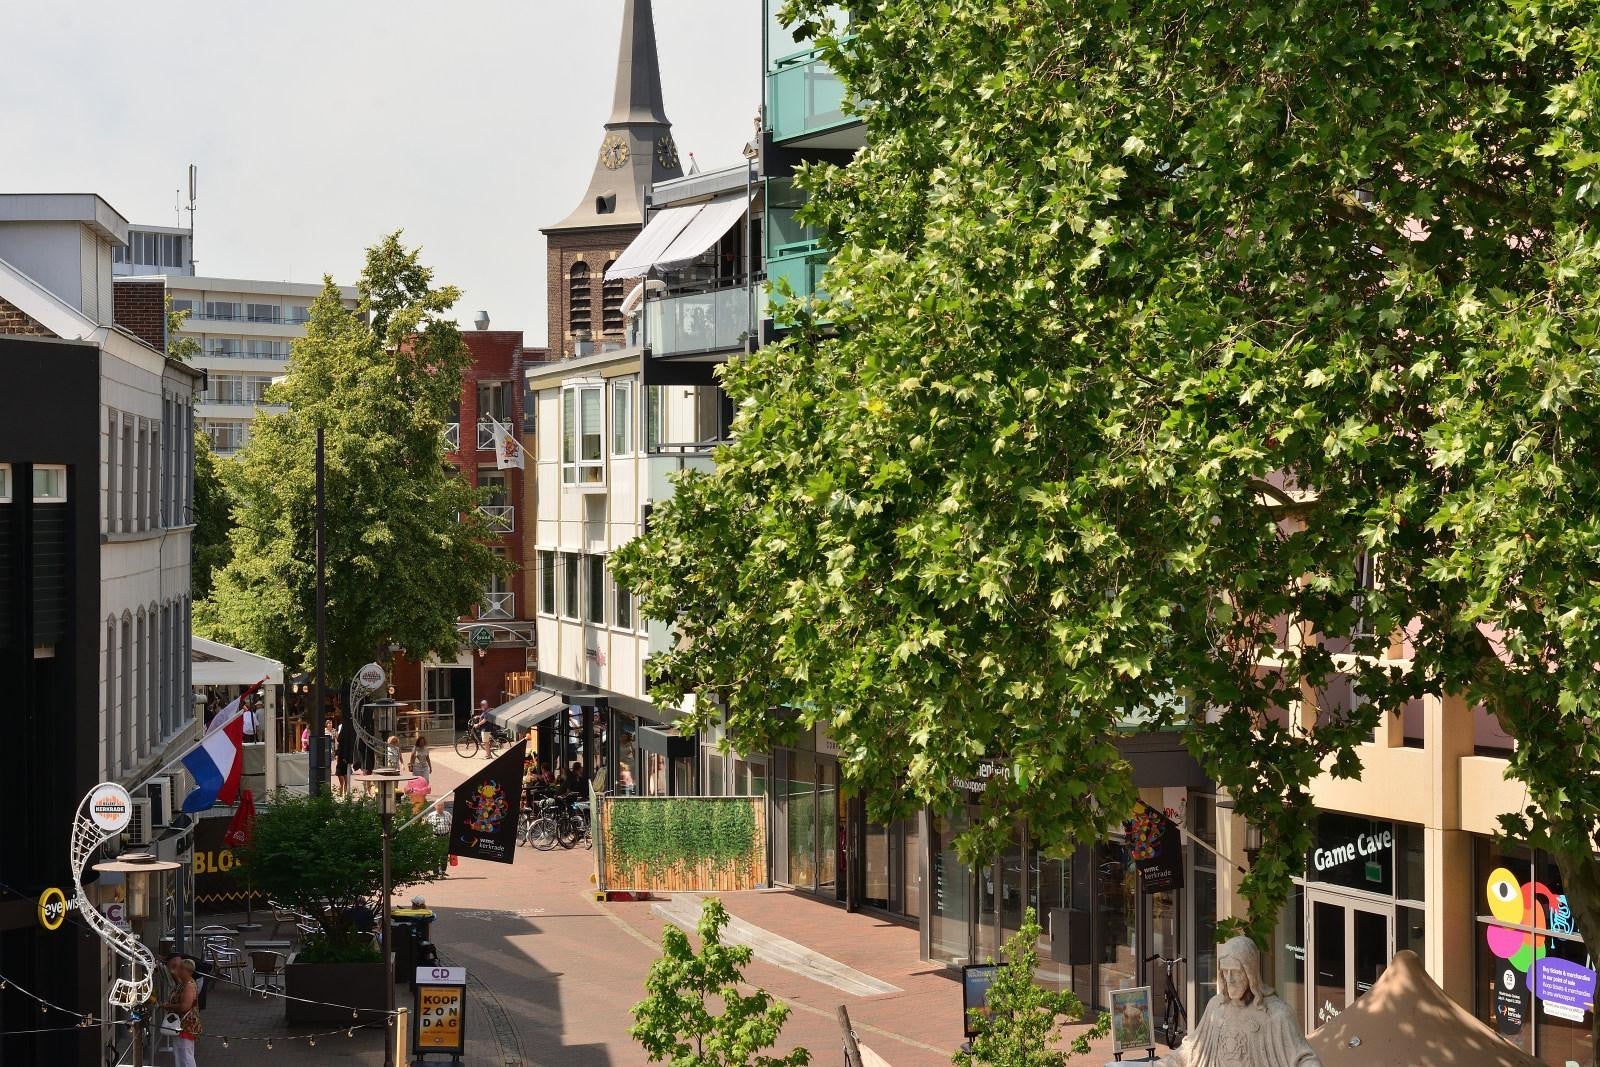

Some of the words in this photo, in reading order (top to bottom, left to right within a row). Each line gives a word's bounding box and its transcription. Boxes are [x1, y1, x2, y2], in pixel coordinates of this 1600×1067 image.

[1314, 848, 1355, 871] Game
[1357, 830, 1391, 856] Cave
[1143, 865, 1159, 873] wmc
[1144, 869, 1172, 880] kerkrade
[431, 968, 450, 979] CD
[423, 995, 458, 1005] KOOP
[422, 1007, 458, 1016] ZON
[423, 1018, 457, 1027] DAG
